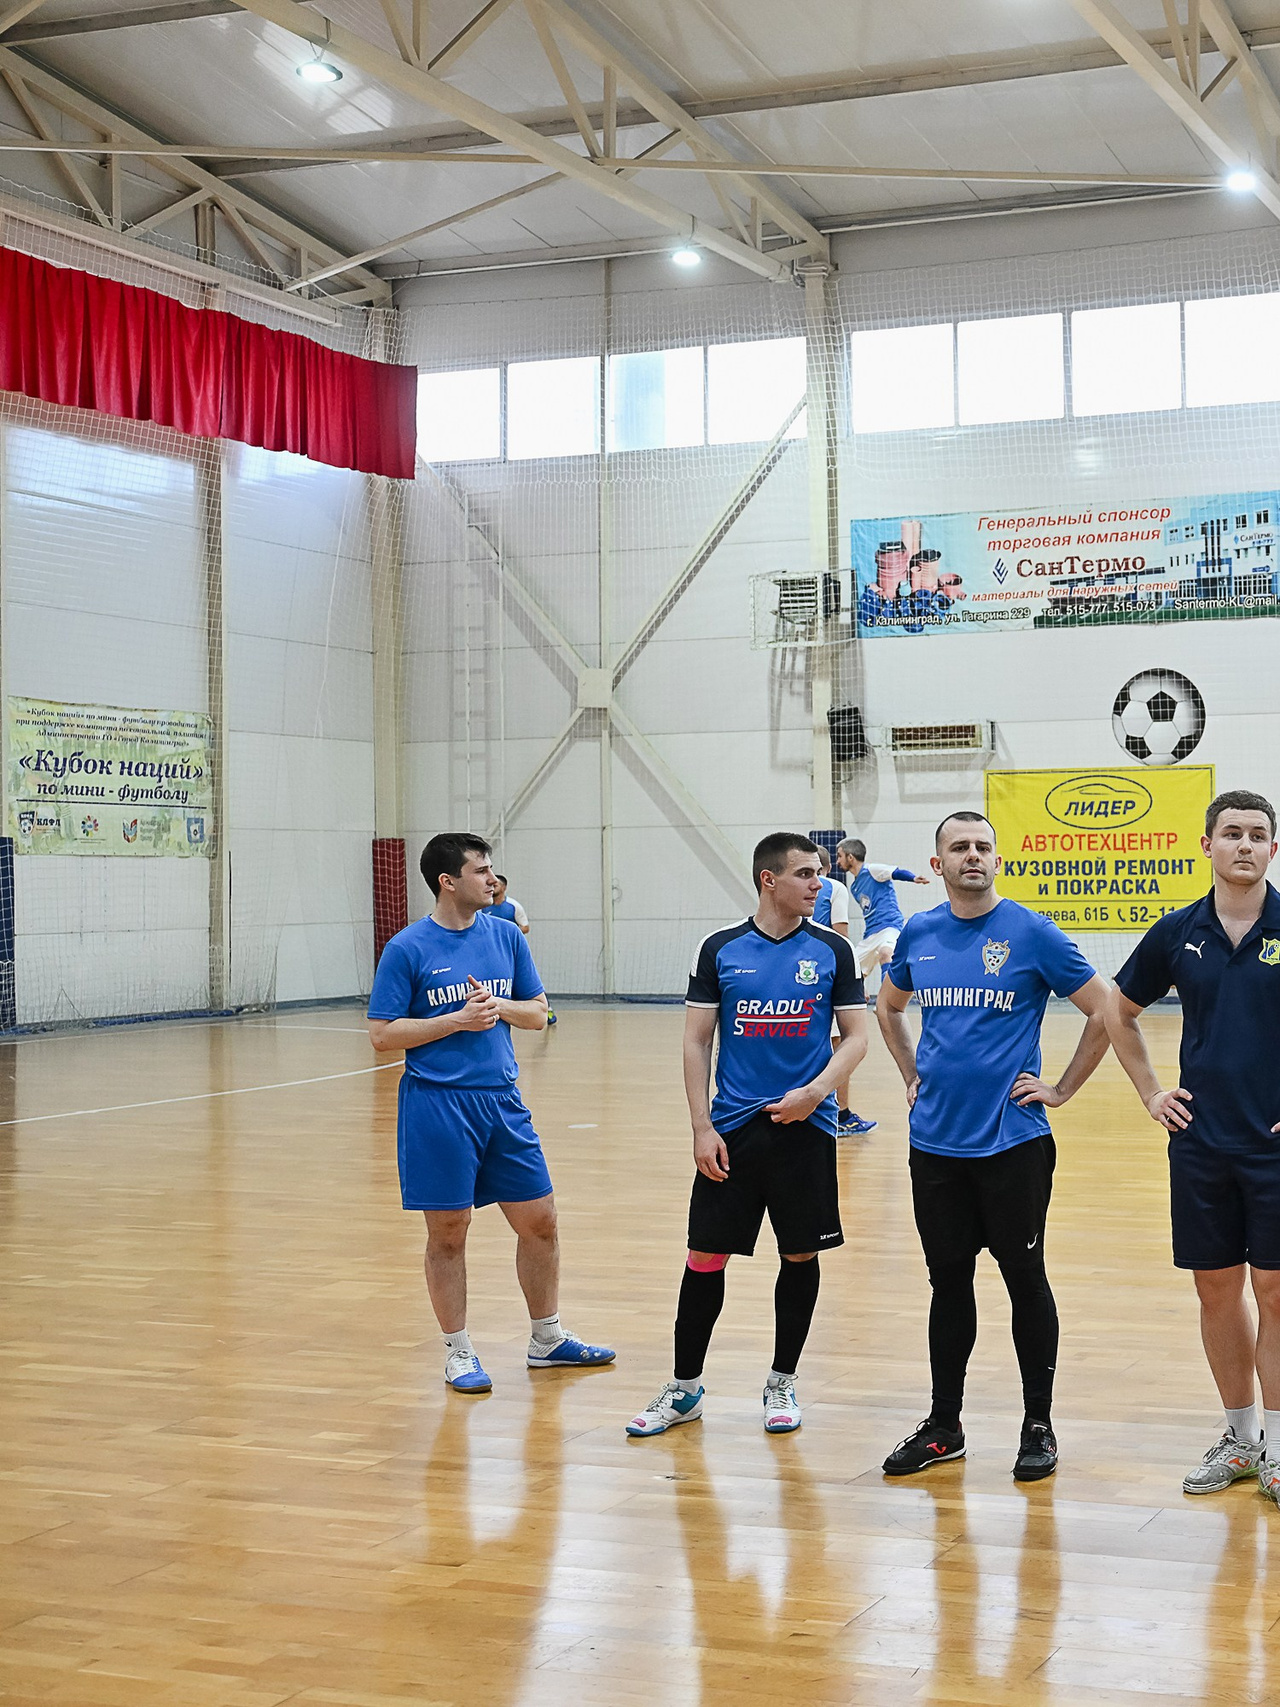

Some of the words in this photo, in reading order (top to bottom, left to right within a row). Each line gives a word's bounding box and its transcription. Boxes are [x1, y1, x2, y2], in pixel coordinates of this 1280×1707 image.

[978, 510, 1093, 532] Генеральный
[1098, 507, 1171, 523] спонсор
[987, 534, 1071, 552] торговая
[1076, 529, 1161, 545] компания
[1016, 556, 1146, 579] СанТермо
[971, 590, 1044, 602] материалы
[1047, 586, 1069, 599] для
[1072, 585, 1135, 599] наружных
[1138, 581, 1179, 592] сетей
[962, 609, 1009, 622] Гагарина
[1010, 607, 1031, 620] 229
[1113, 601, 1156, 613] 515-073
[19, 749, 113, 779] «Кубок
[119, 758, 204, 784] наций»
[37, 783, 57, 796] по
[61, 783, 106, 797] мини
[117, 784, 189, 804] футболу
[1064, 800, 1136, 818] ЛИДЕР
[1021, 832, 1178, 854] АВТОТЕХЦЕНТР
[1004, 856, 1107, 877] КУЗОВНОЙ
[1114, 859, 1196, 876] РЕМОНТ
[1038, 883, 1049, 895] и
[1056, 879, 1161, 896] ПОКРАСКА
[1084, 906, 1109, 921] 61Б
[733, 1017, 811, 1038] SERVICE
